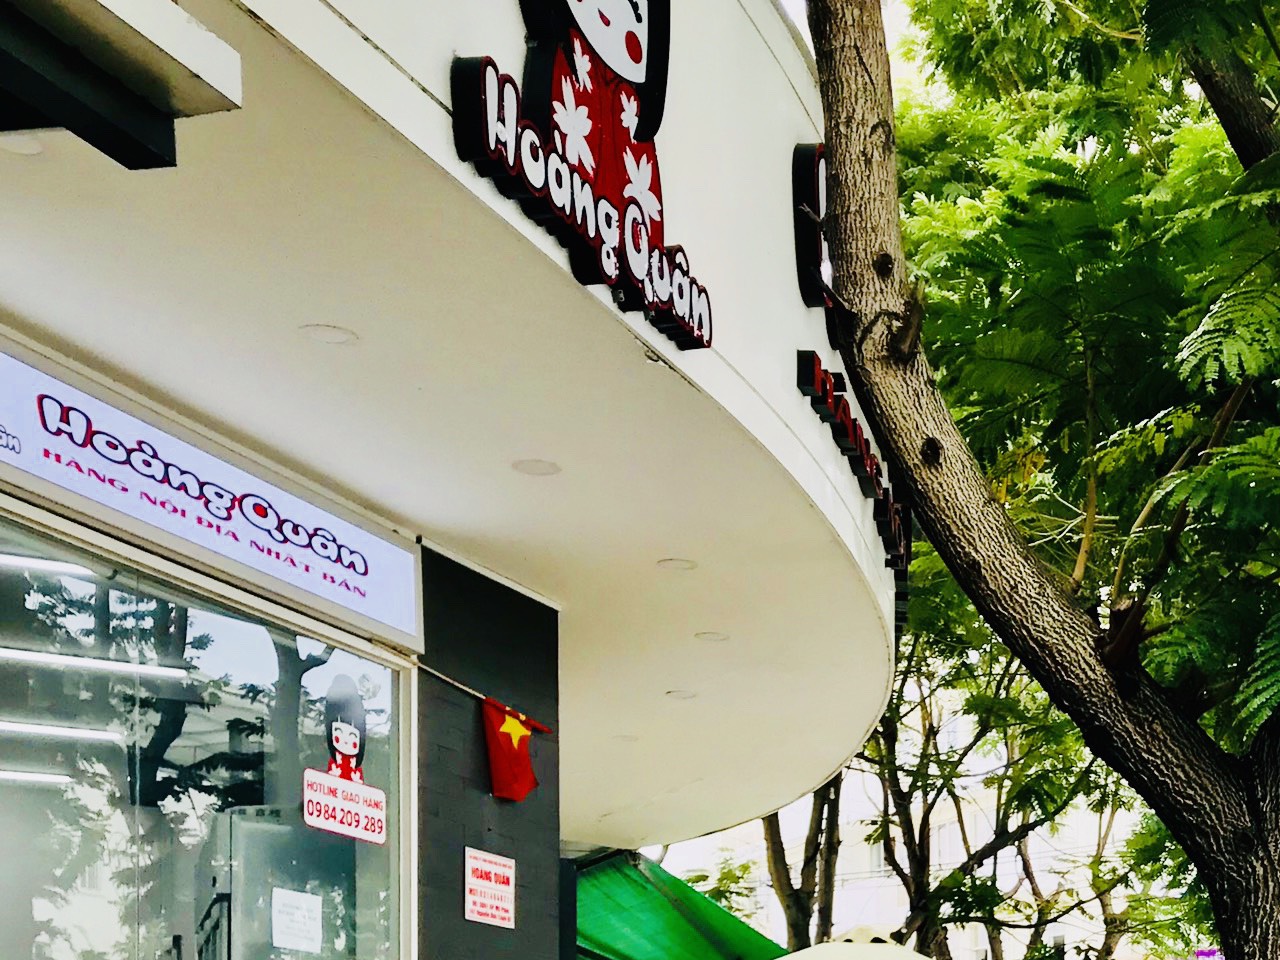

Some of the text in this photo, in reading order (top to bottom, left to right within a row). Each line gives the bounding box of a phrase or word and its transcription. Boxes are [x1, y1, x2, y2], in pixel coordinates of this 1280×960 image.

[43, 448, 128, 493] HÀNG
[140, 491, 186, 518] NỘI
[306, 780, 338, 798] HOTLINE
[341, 790, 360, 804] GIAO
[307, 799, 383, 834] 0984.209.289
